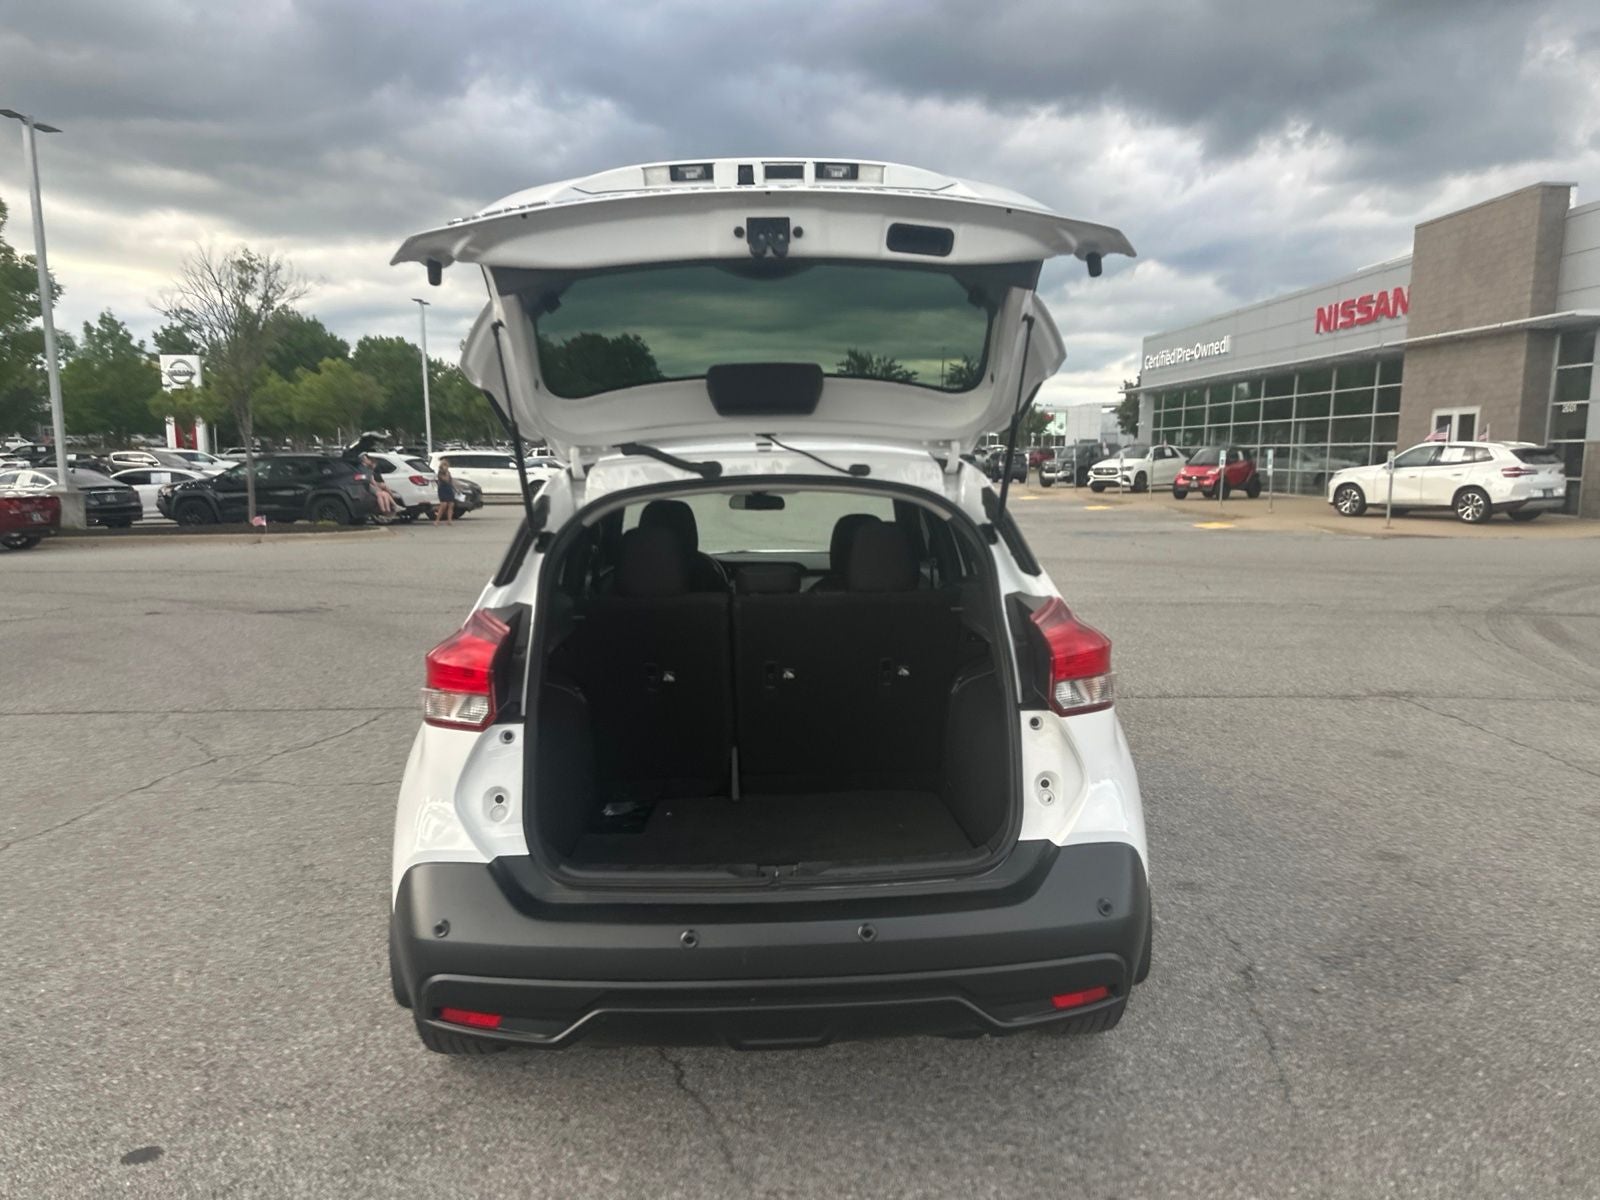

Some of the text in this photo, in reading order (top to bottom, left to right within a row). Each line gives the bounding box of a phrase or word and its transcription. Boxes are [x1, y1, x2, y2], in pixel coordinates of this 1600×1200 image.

[1315, 287, 1409, 334] NISSAN
[1144, 335, 1231, 370] Certified Pre-Owned
